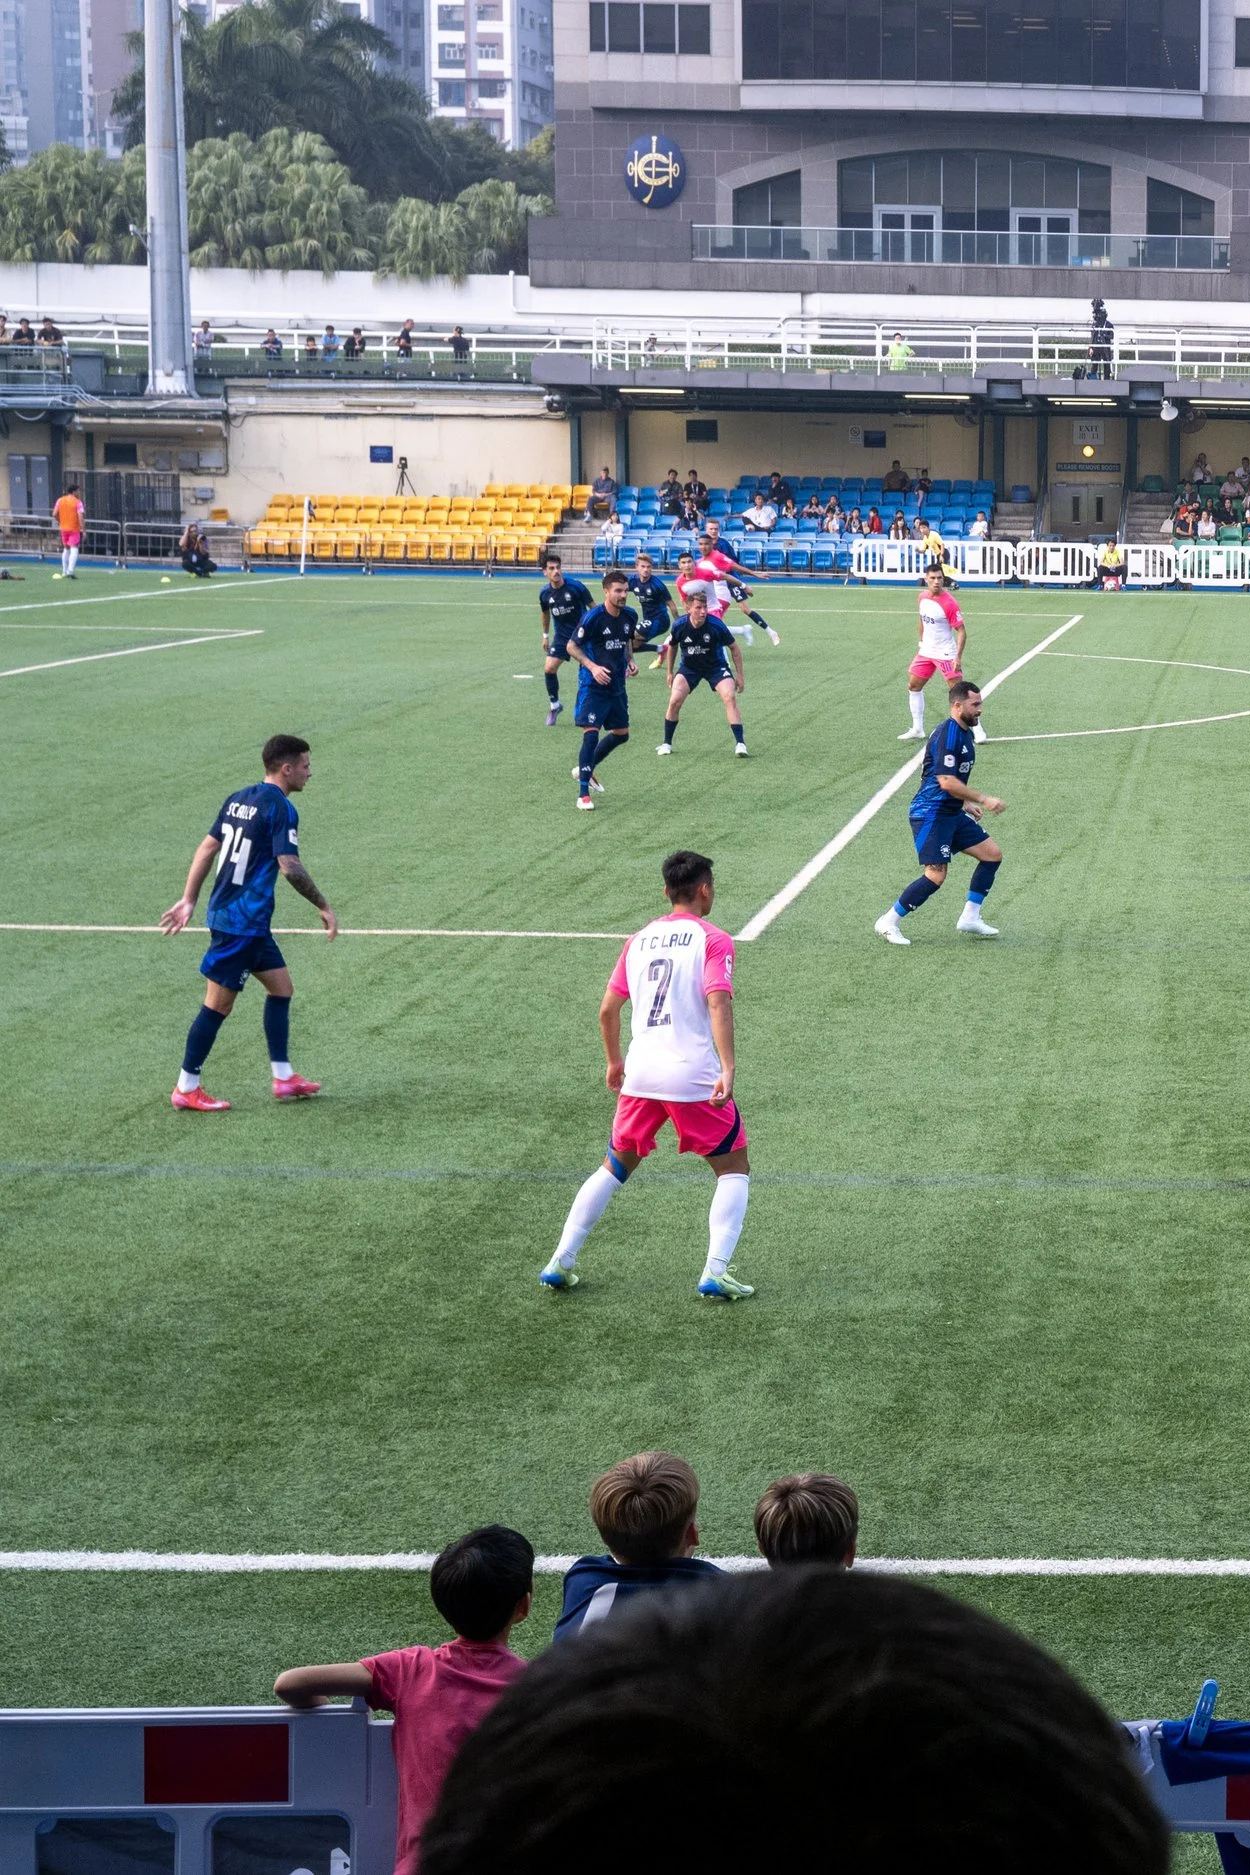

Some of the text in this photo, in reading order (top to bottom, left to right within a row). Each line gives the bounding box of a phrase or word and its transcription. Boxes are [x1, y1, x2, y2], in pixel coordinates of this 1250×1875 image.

[640, 932, 693, 952] T C LAW
[646, 958, 674, 1028] 2
